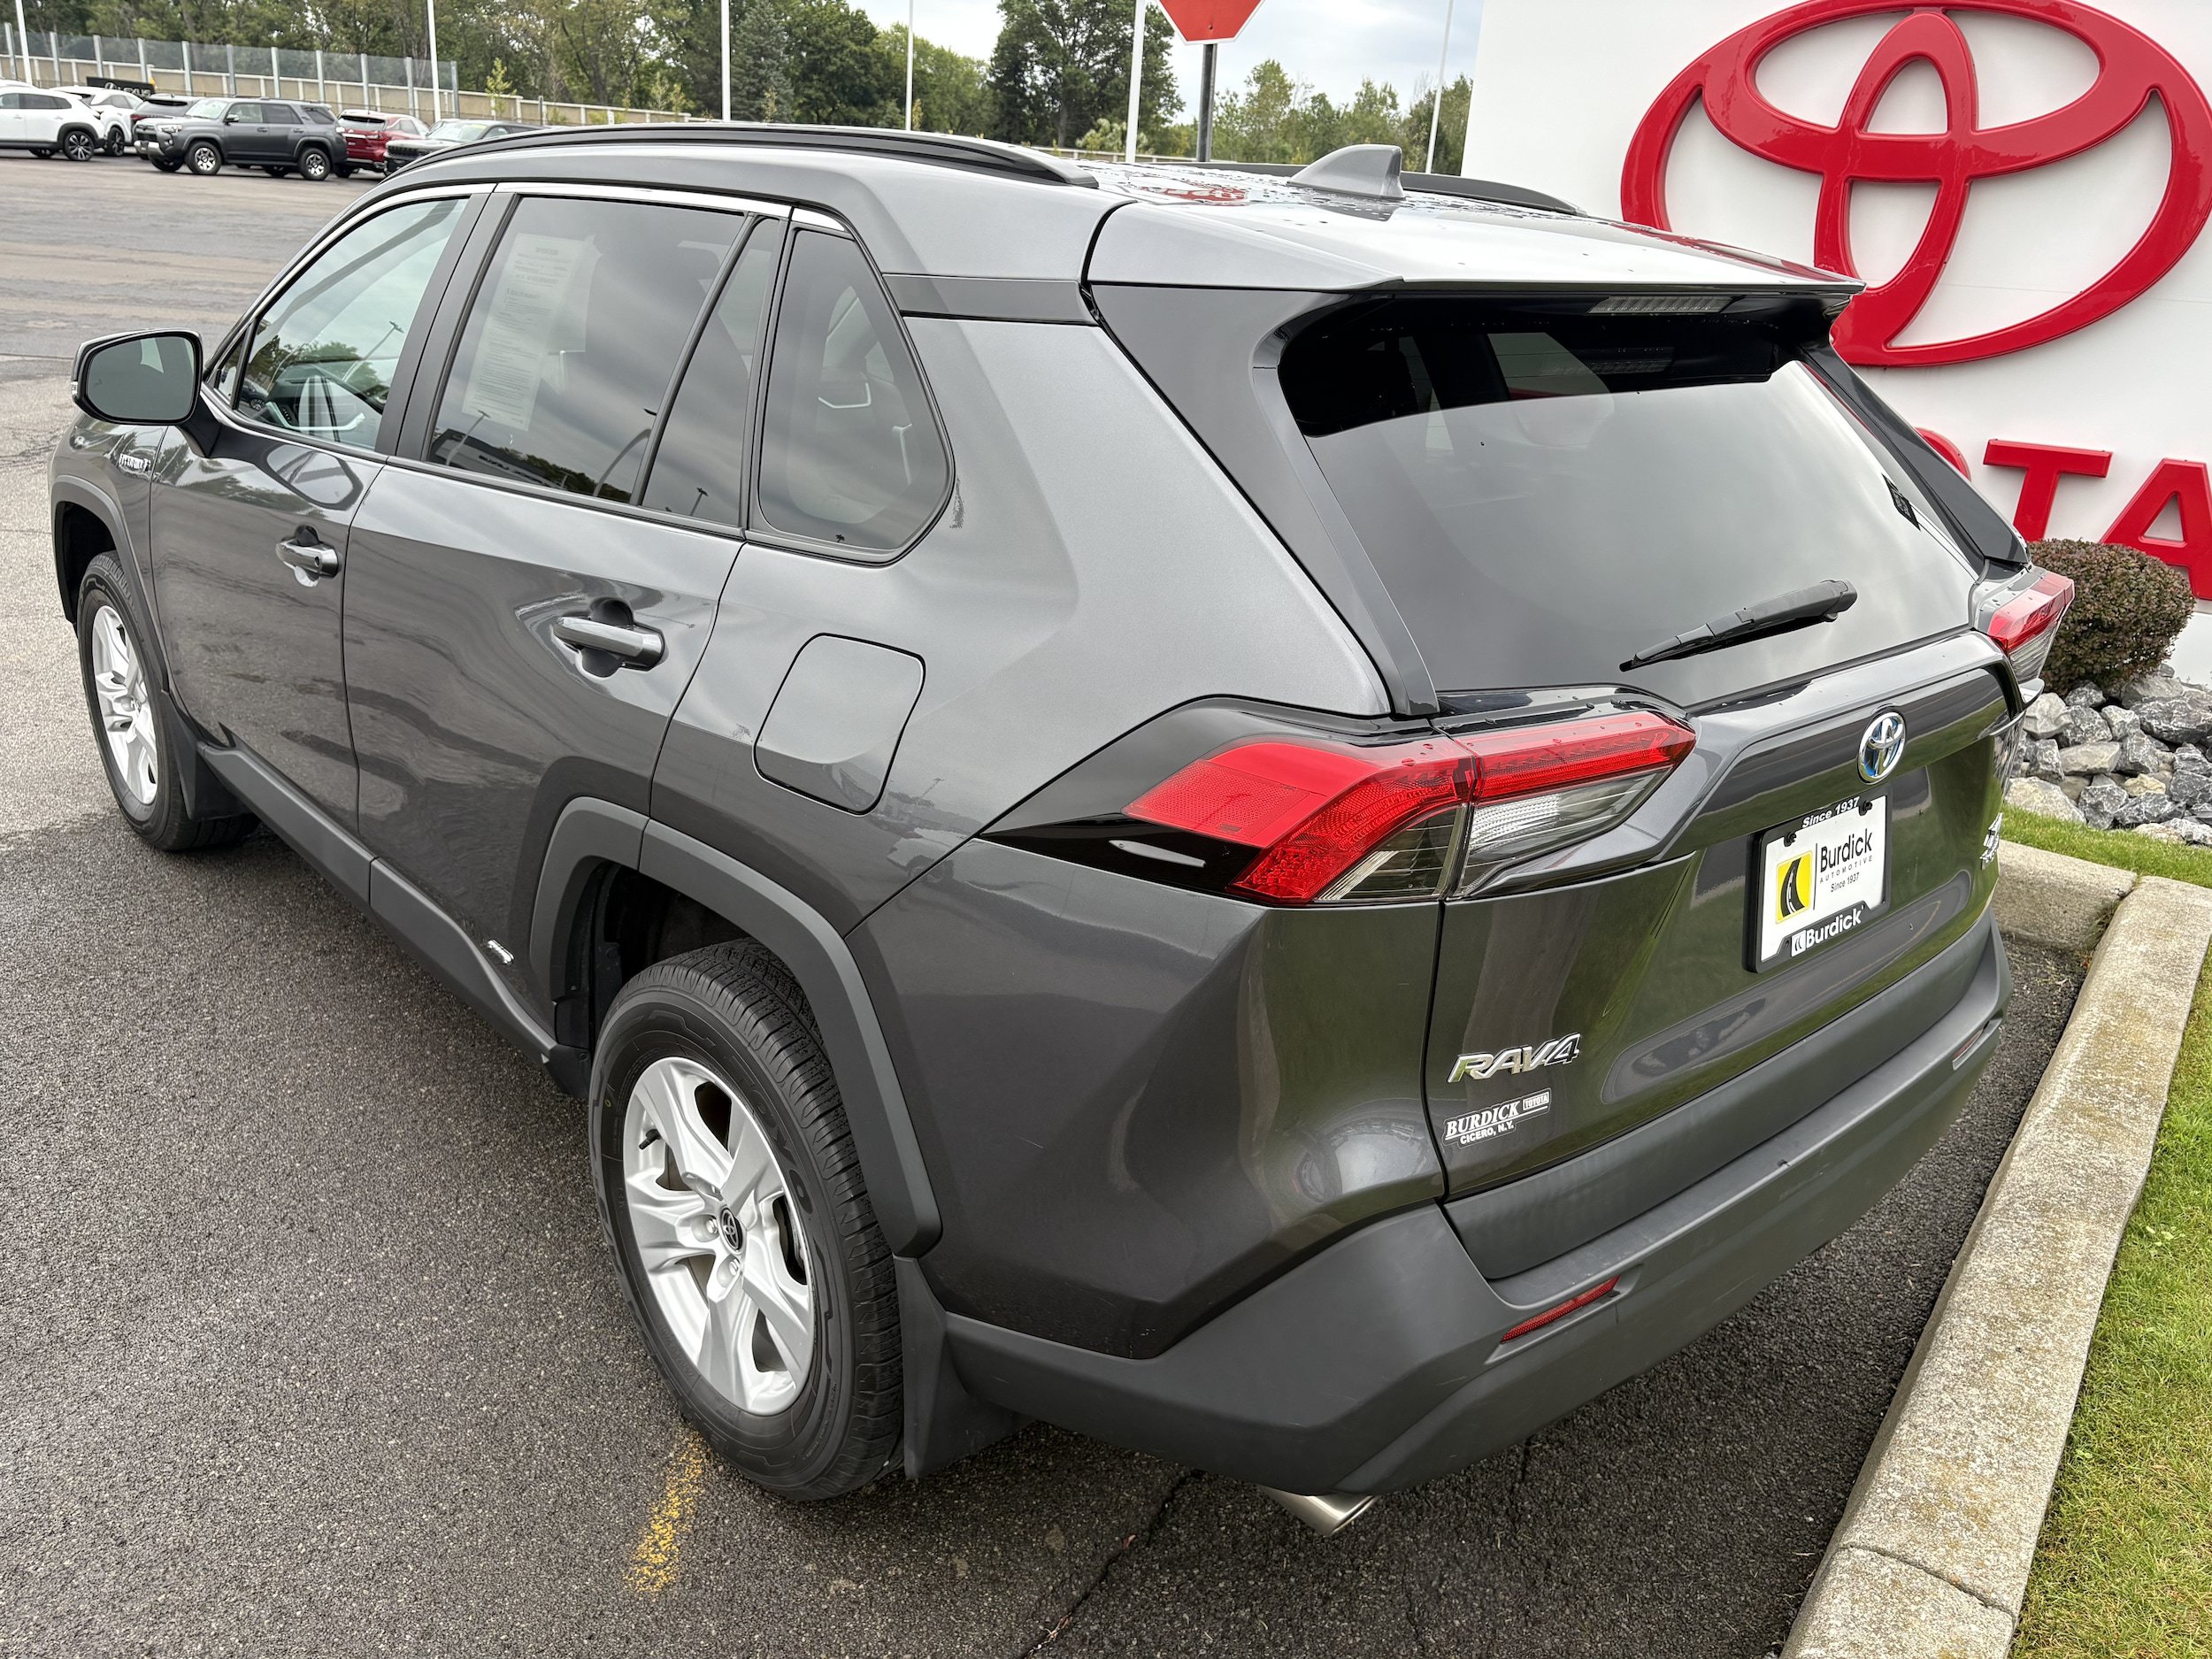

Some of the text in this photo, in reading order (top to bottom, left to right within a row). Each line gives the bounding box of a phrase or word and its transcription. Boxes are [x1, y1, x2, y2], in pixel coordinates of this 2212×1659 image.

[1914, 426, 2212, 603] TA
[1801, 795, 1860, 828] Since 1937
[1819, 855, 1873, 884] AUTOMOTIVE
[1820, 827, 1873, 873] Burdick
[1830, 872, 1860, 893] Since 1937
[1806, 908, 1862, 949] Burdick
[1448, 1032, 1581, 1084] RAV4
[1445, 1094, 1548, 1138] BURDICK TOYOTA
[1459, 1120, 1515, 1145] CICERO, N.Y.
